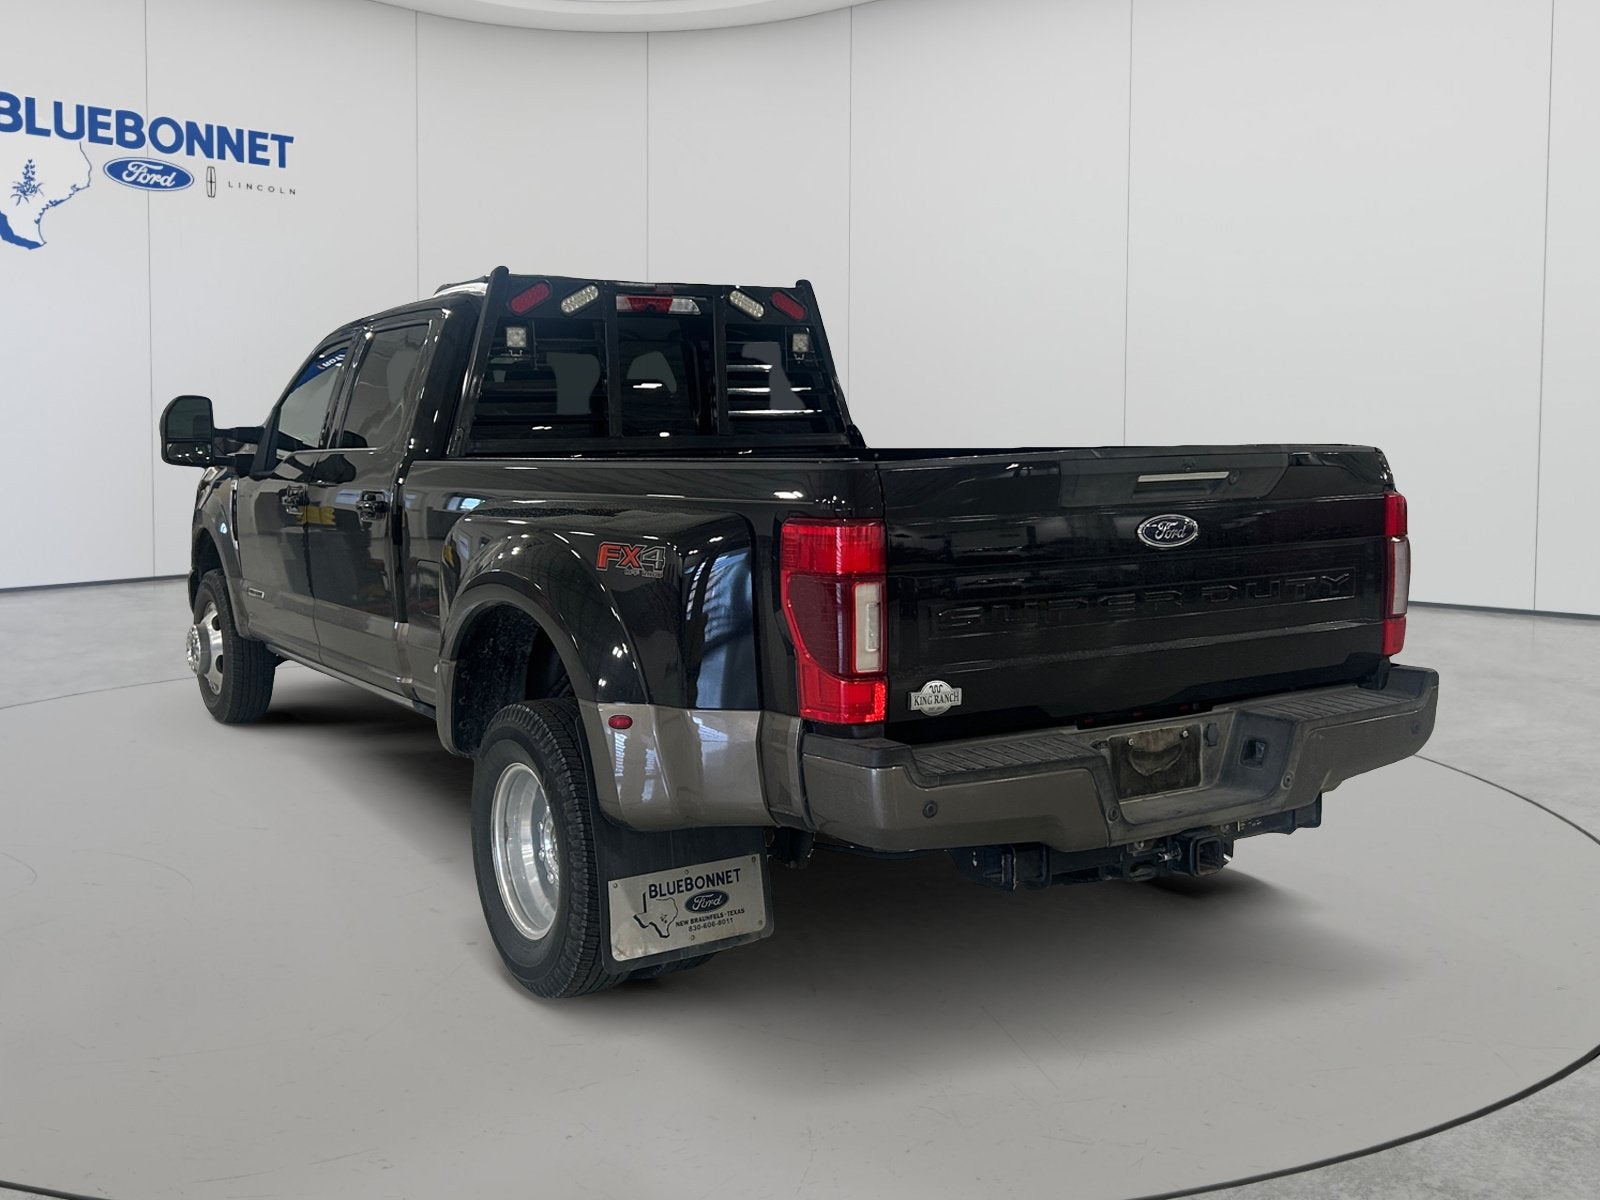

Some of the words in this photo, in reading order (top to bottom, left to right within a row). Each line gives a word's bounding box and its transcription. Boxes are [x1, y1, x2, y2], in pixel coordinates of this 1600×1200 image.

[0, 91, 294, 168] BLUEBONNET
[122, 161, 176, 187] Ford
[228, 181, 296, 195] LINCOLN
[596, 542, 666, 572] FX4
[938, 590, 1184, 627] SUPER
[1201, 573, 1350, 604] DUTY
[914, 695, 933, 706] KING
[934, 691, 959, 704] RANCH
[649, 868, 741, 899] BLUEBONNET
[692, 893, 723, 911] Ford
[676, 919, 690, 928] NEW
